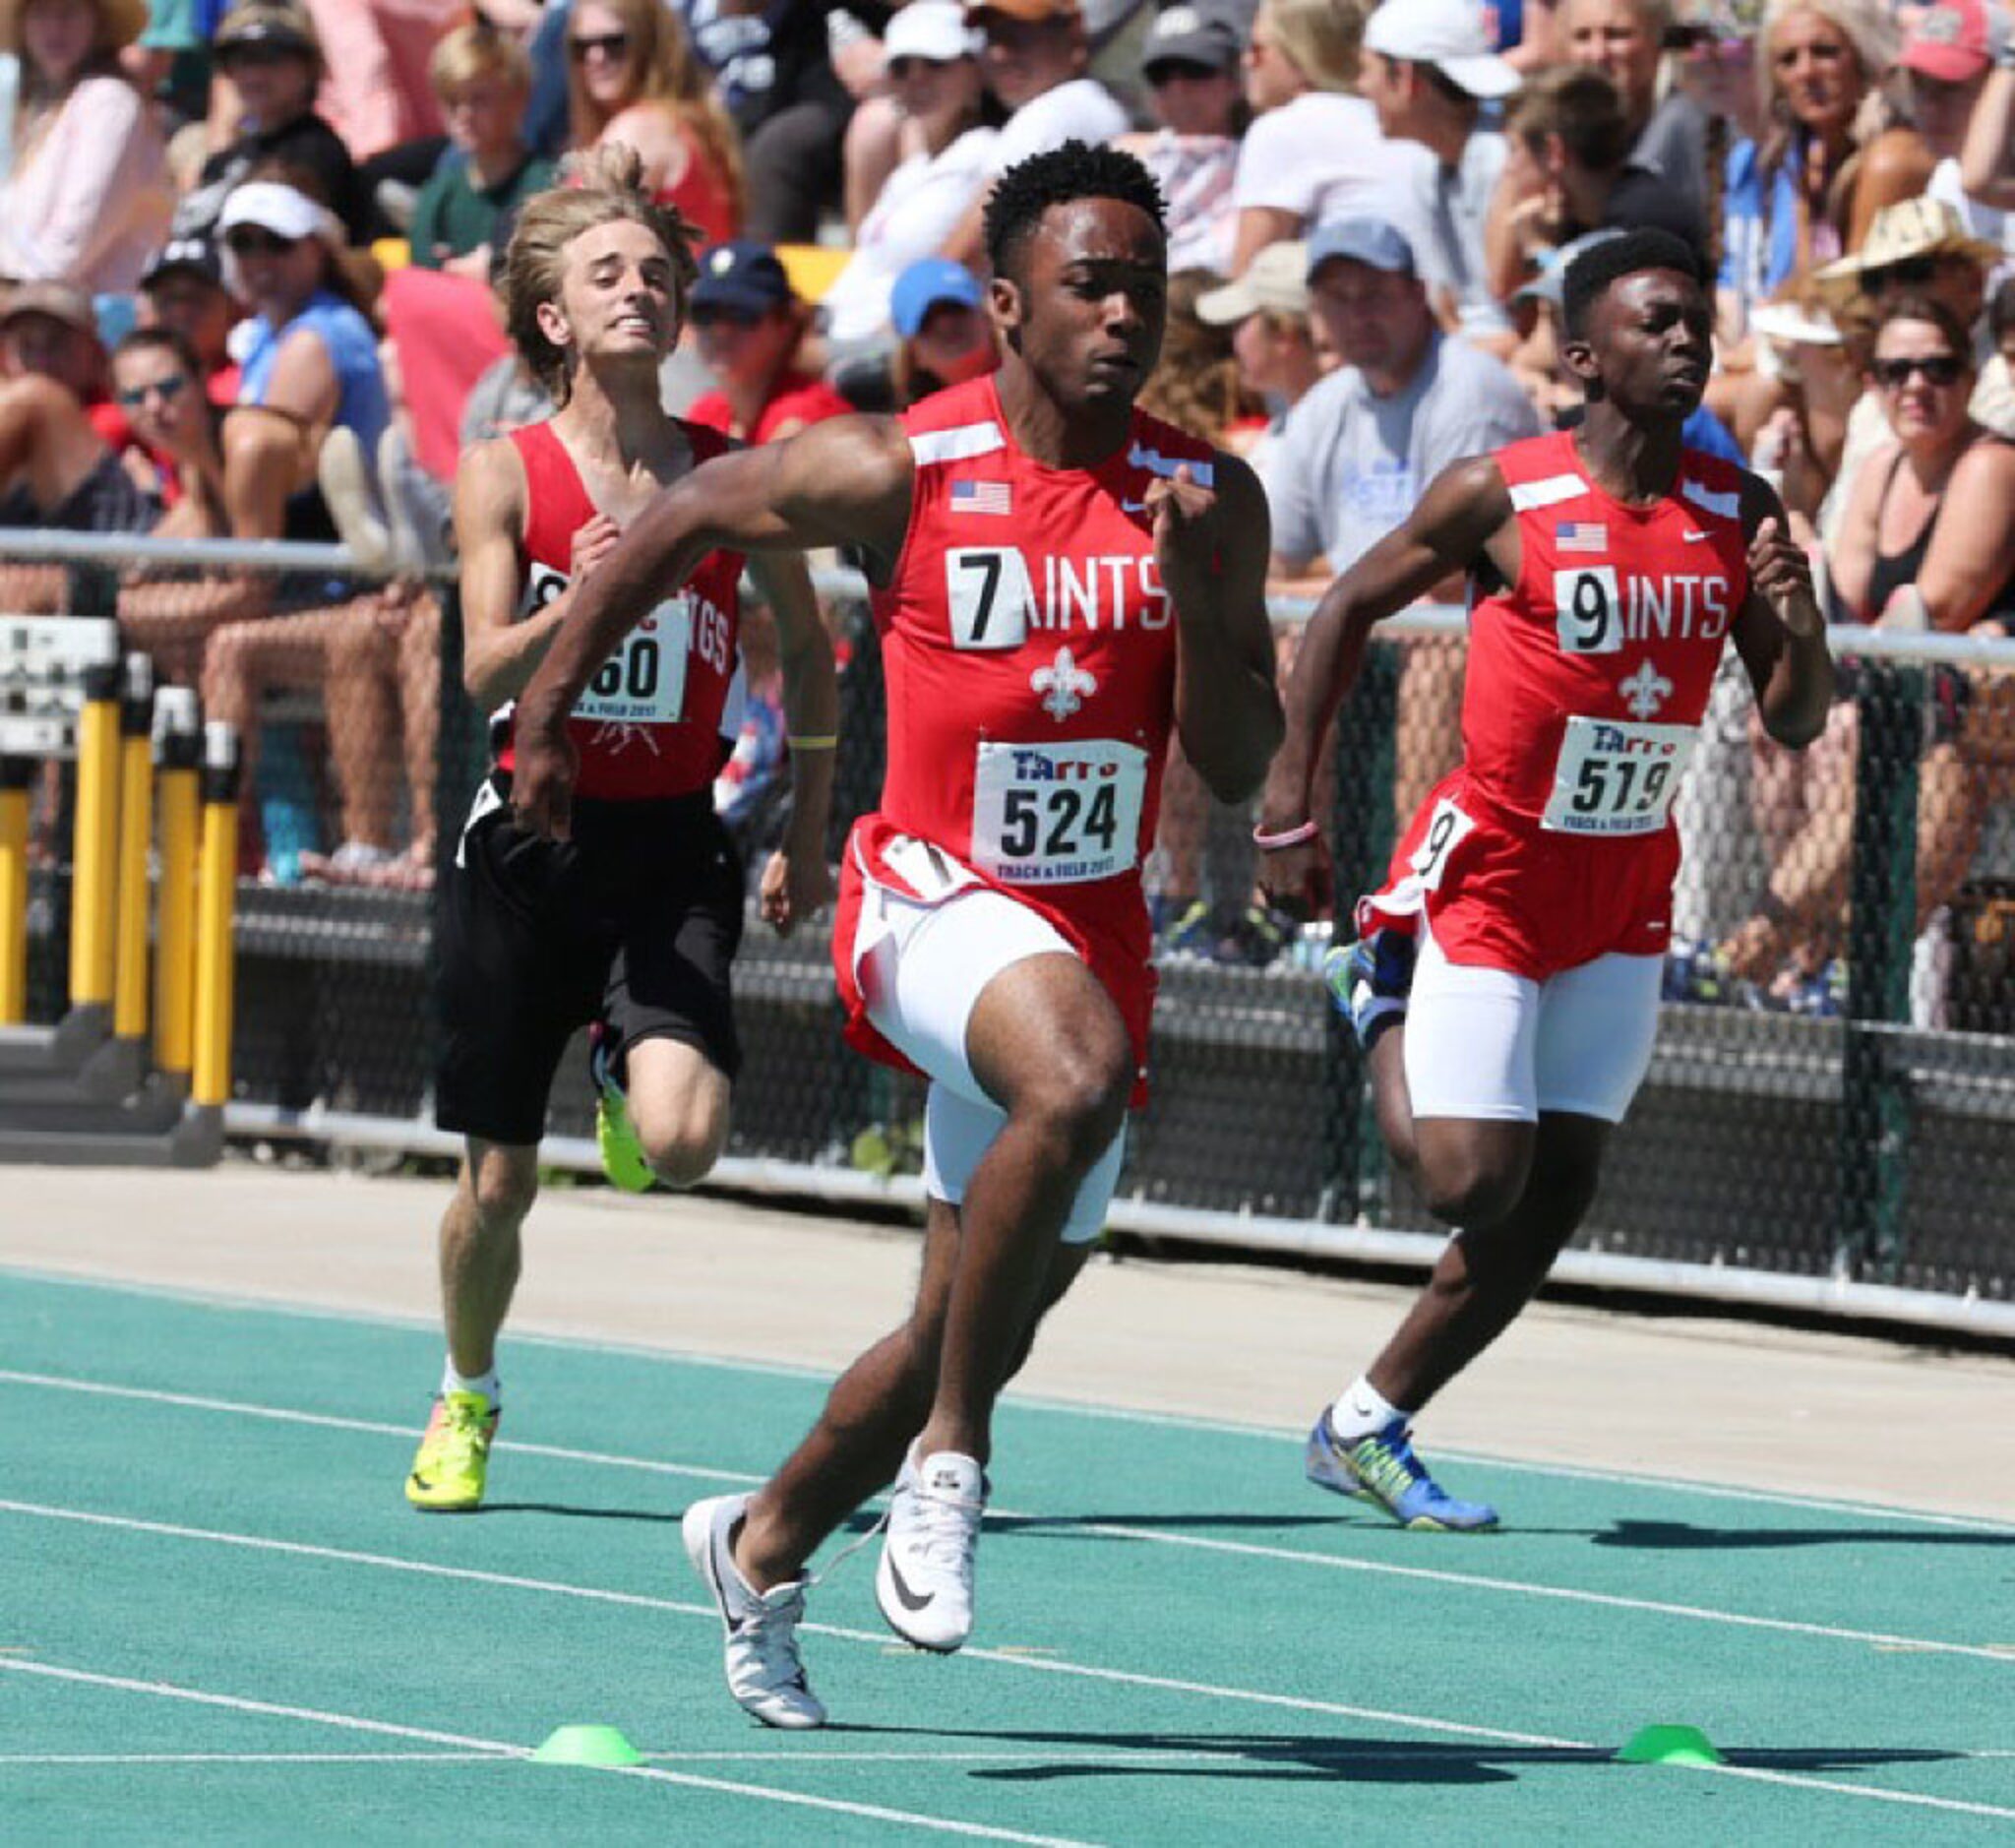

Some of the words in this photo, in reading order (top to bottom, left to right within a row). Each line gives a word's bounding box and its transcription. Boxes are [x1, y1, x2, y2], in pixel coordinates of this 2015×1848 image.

[960, 554, 1002, 641] 7
[1572, 572, 1608, 649] 9
[1001, 784, 1117, 857] 524
[1572, 758, 1671, 812] 519
